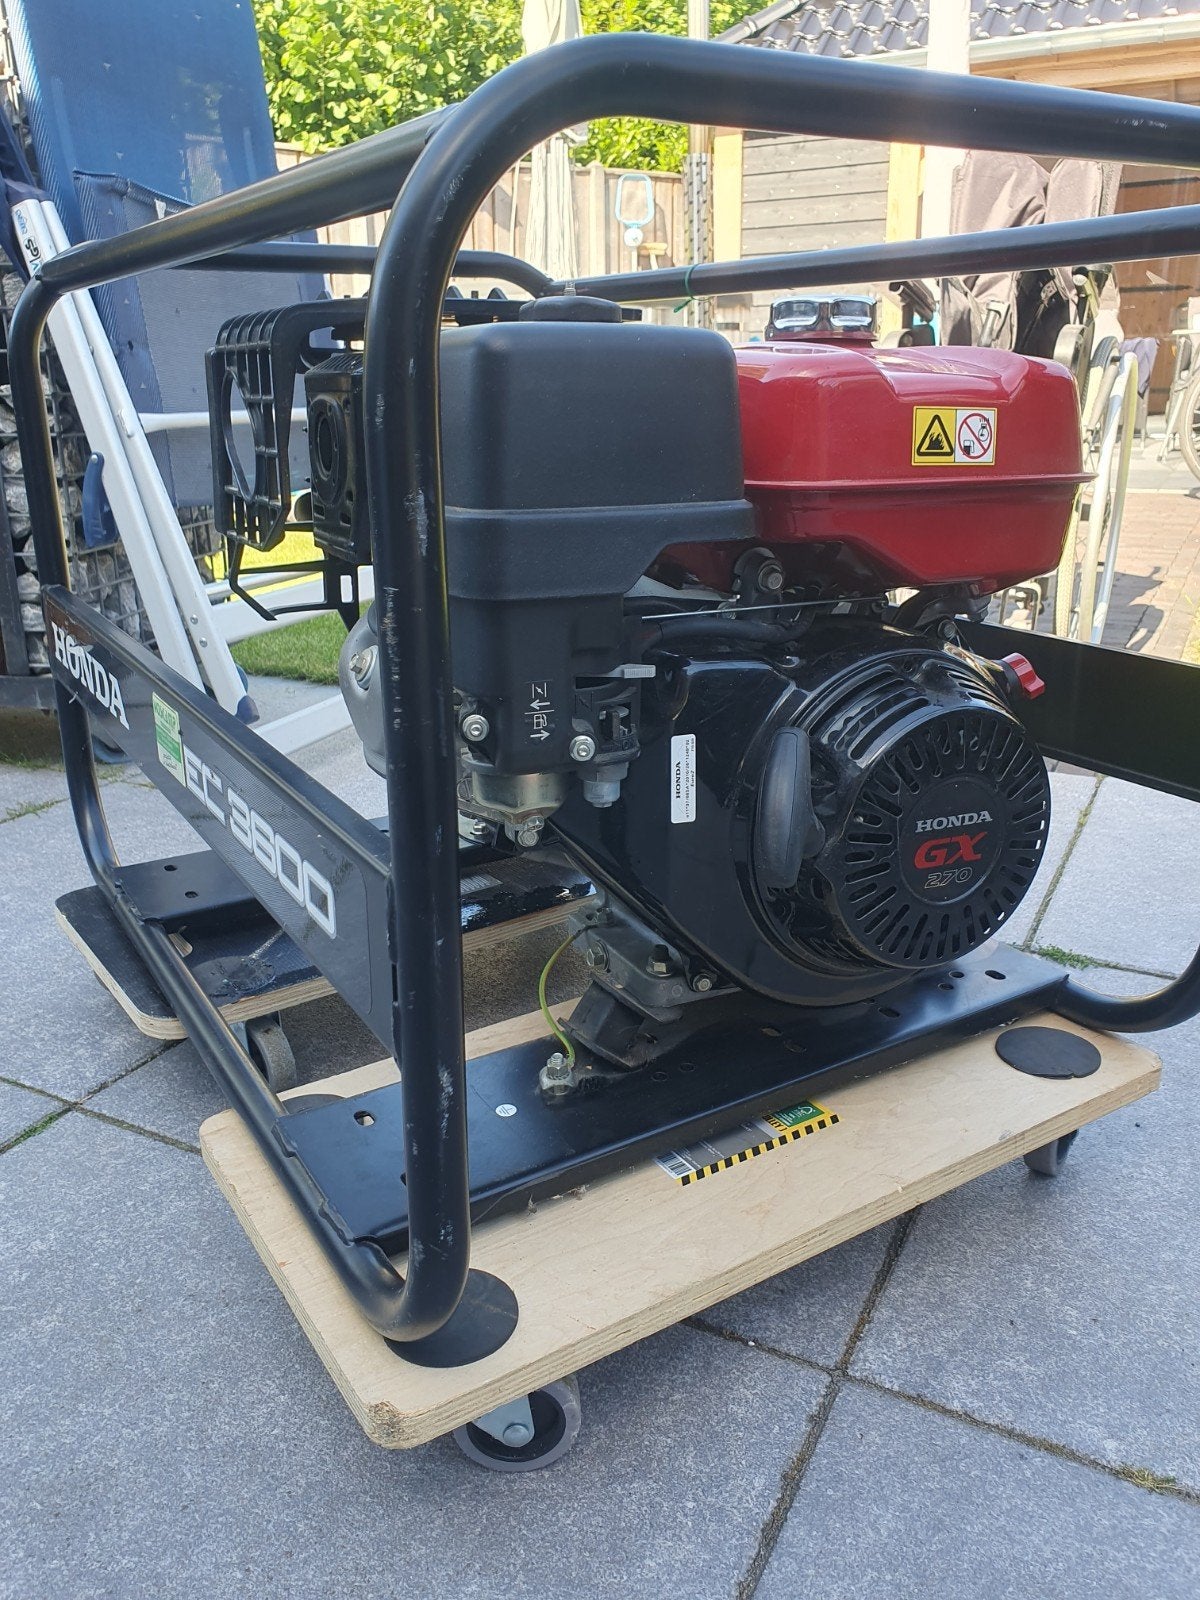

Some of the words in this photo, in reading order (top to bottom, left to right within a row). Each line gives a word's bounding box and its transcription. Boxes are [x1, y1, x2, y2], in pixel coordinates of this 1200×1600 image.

[51, 621, 130, 730] HONDA
[915, 810, 993, 833] HONDA
[183, 744, 226, 827] EC
[227, 786, 336, 940] 3600
[914, 831, 987, 870] GX
[924, 866, 973, 889] 270
